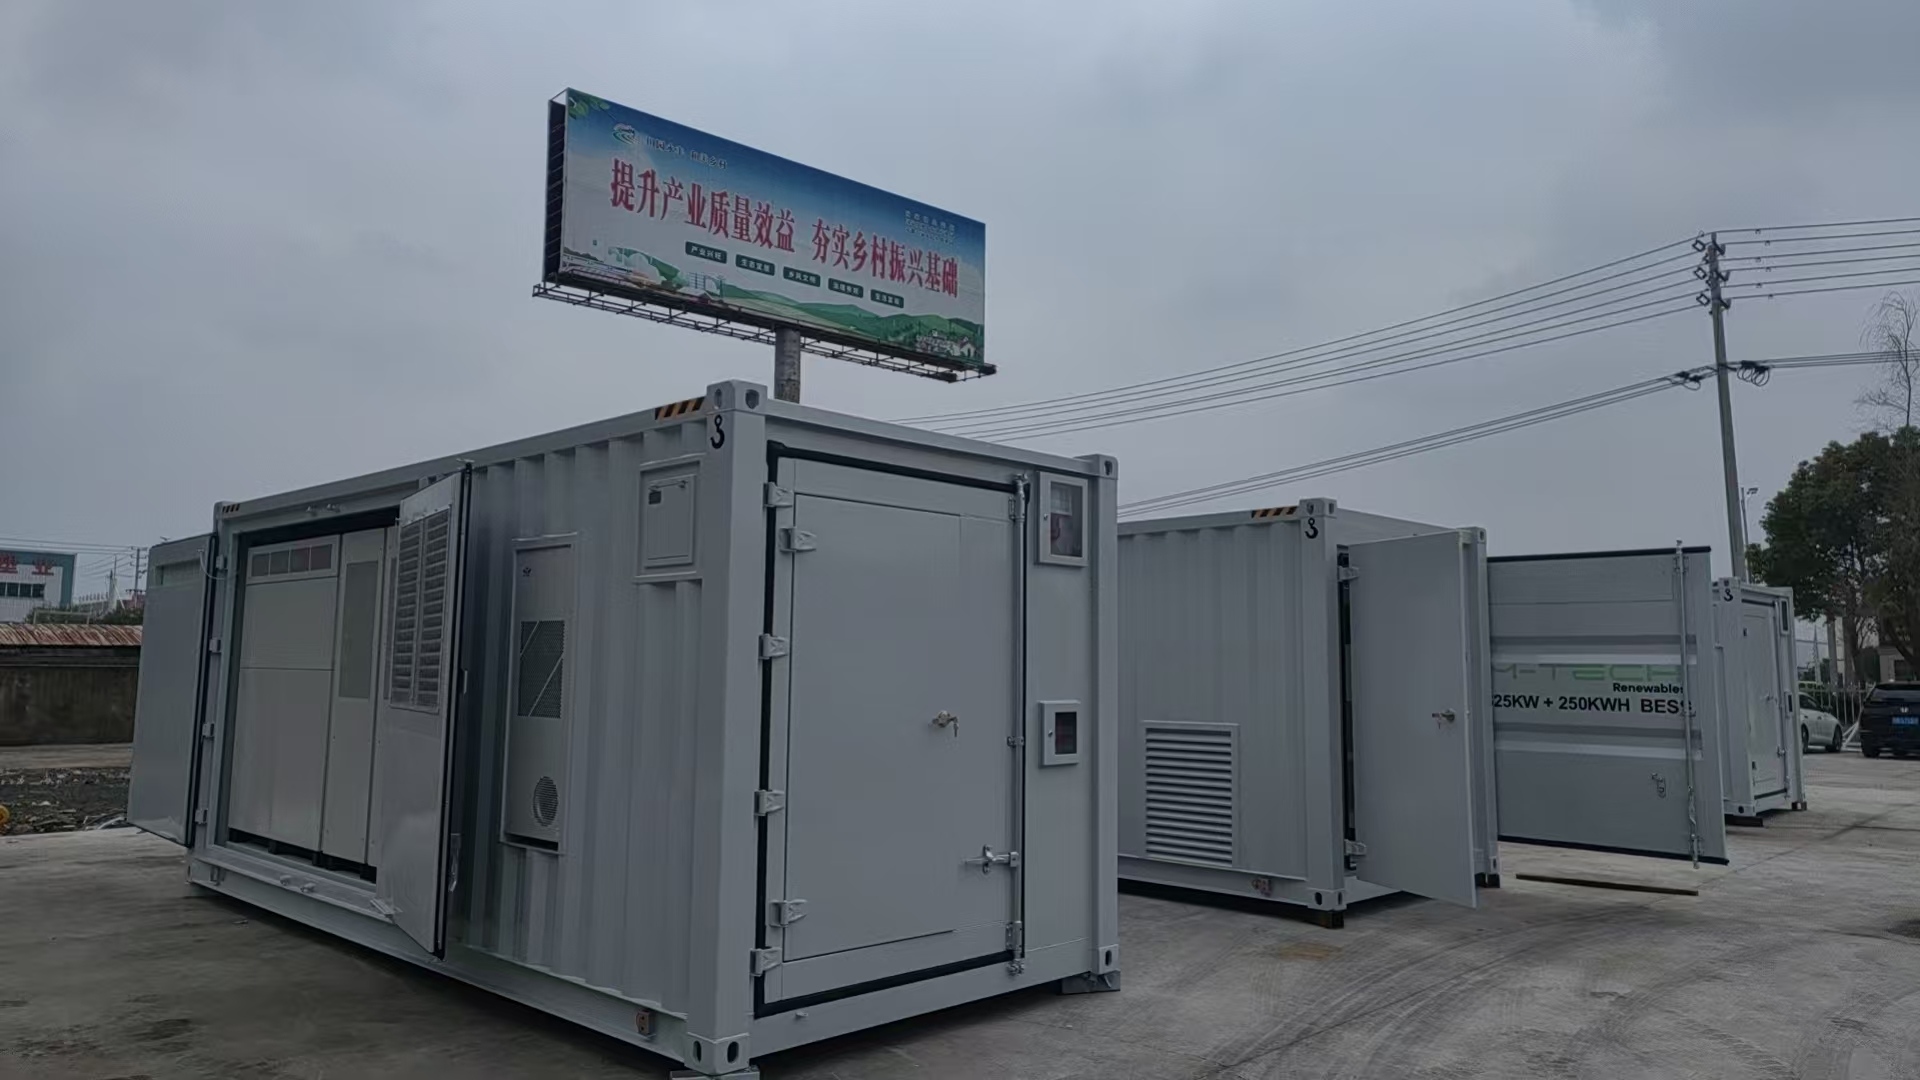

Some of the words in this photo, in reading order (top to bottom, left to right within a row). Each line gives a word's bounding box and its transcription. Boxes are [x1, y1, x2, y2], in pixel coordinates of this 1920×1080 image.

[610, 158, 795, 253] 提升产业质量效益
[811, 218, 959, 298] 夯实乡村振兴基础
[1492, 694, 1540, 709] 25KW
[1543, 697, 1554, 708] +
[1558, 696, 1630, 712] 250KWH
